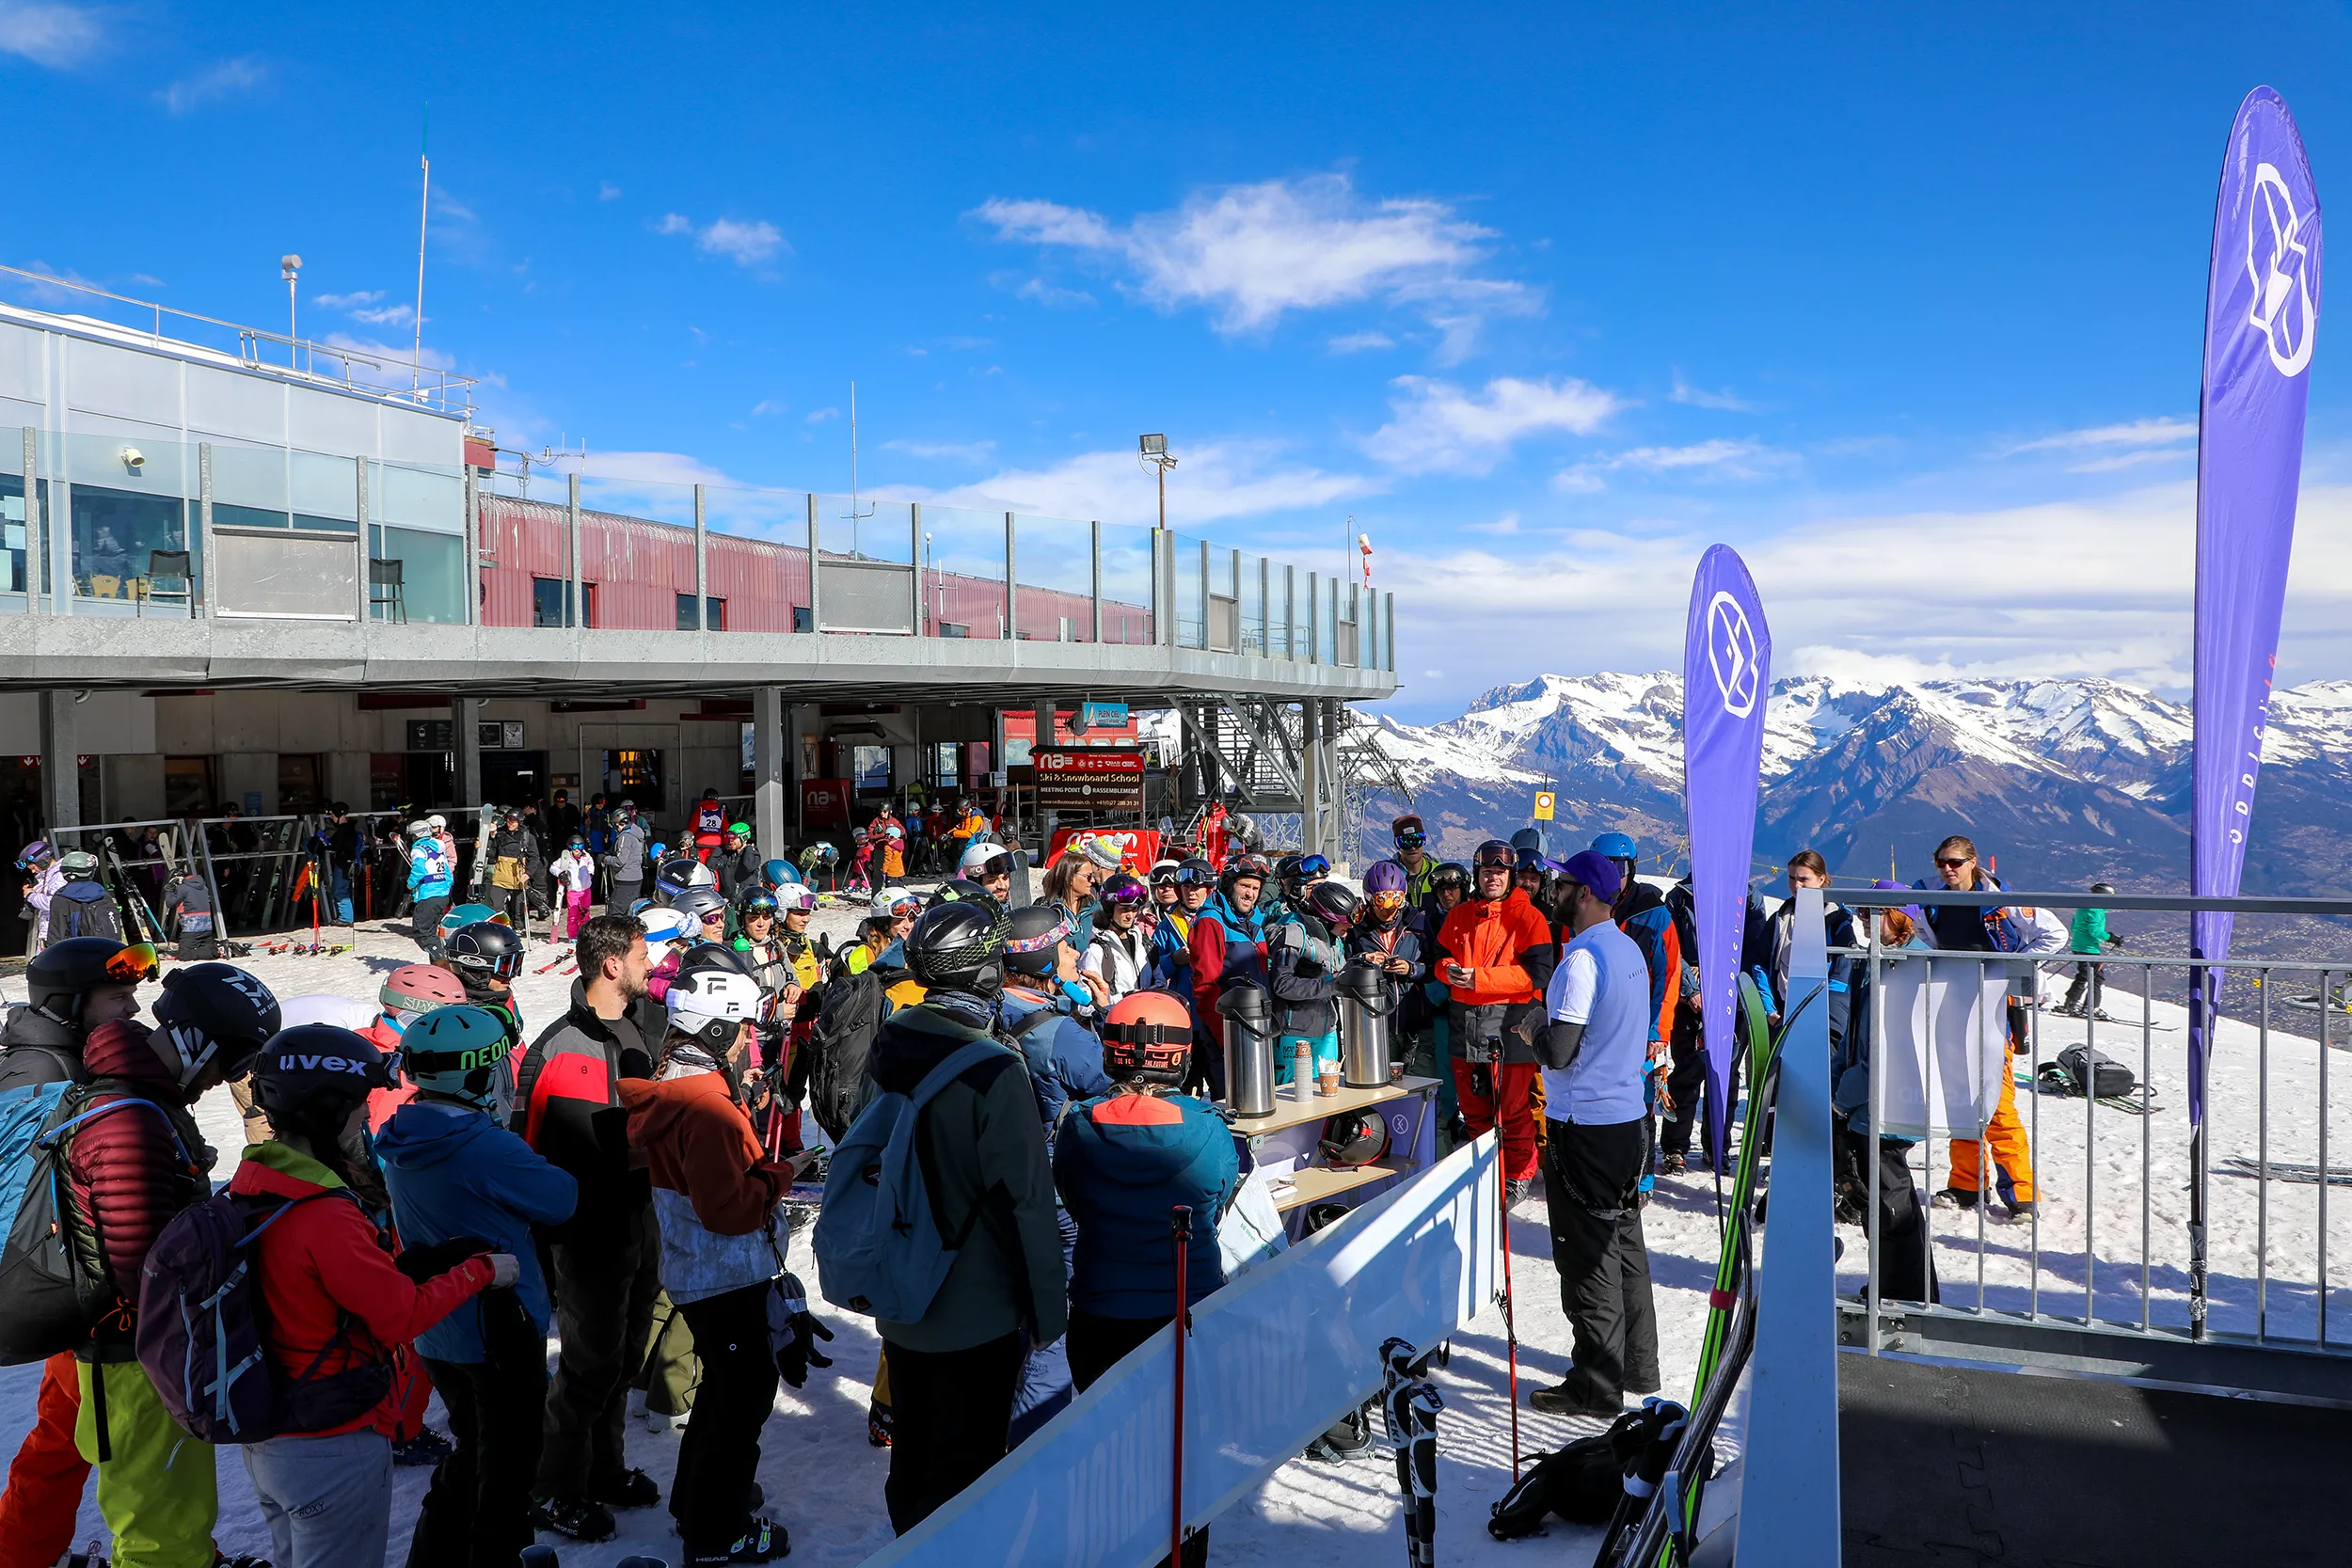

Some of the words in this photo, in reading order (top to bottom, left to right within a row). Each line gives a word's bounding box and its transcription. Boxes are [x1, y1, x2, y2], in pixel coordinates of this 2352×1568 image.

[1040, 773, 1053, 782] Ski
[1061, 773, 1109, 783] Snowboard
[1110, 773, 1139, 783] School
[706, 818, 717, 827] 28
[279, 1054, 368, 1077] uvex
[1387, 1409, 1401, 1444] LEKI
[299, 1501, 325, 1517] ROXY
[553, 1523, 579, 1536] ATOMIC
